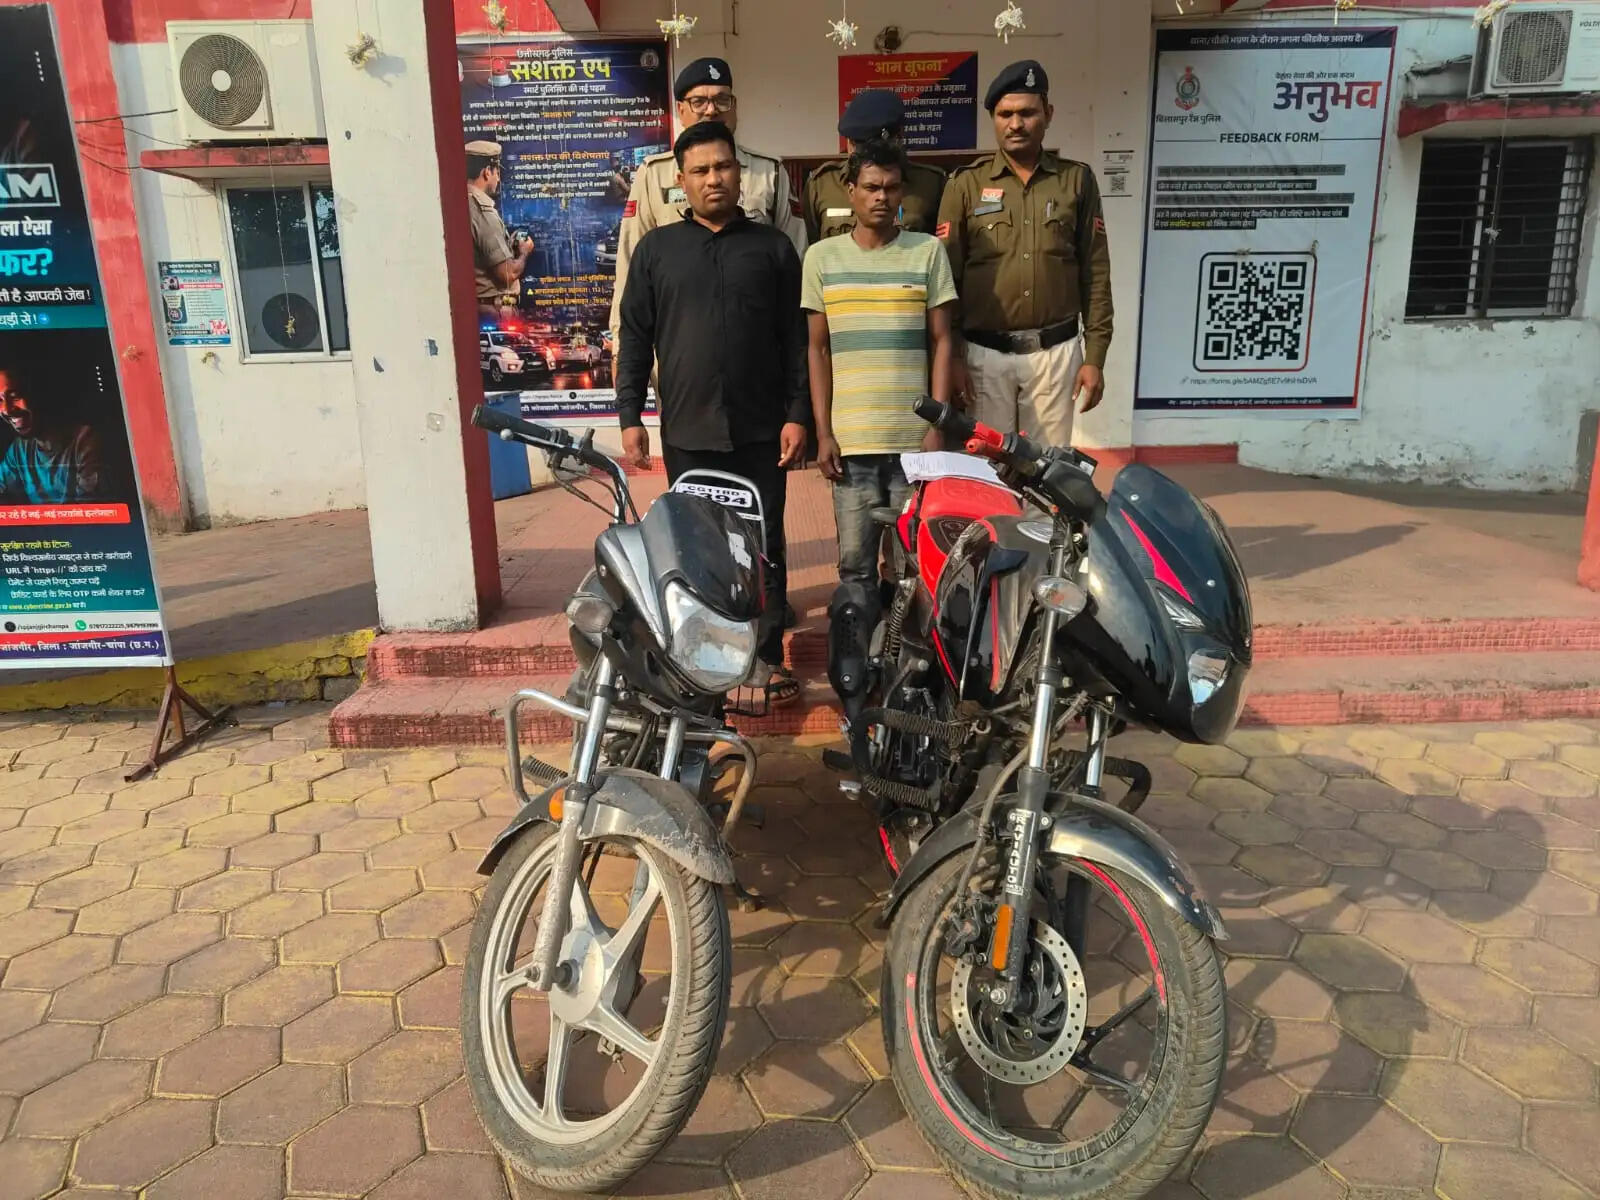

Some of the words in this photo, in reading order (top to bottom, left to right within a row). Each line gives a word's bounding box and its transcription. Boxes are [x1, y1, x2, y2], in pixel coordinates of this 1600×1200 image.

[552, 48, 573, 60] पुलिस
[510, 60, 575, 81] सशक्त
[581, 57, 611, 80] एप
[568, 84, 578, 92] की
[1273, 81, 1382, 122] अनुभव
[1201, 113, 1221, 125] पुलिस
[1220, 133, 1282, 143] FEEDBACK
[1285, 132, 1319, 142] FORM
[22, 216, 52, 235] ऐसा
[24, 287, 62, 301] आपकी
[43, 540, 51, 549] के
[83, 552, 90, 560] से
[38, 641, 60, 651] जिला
